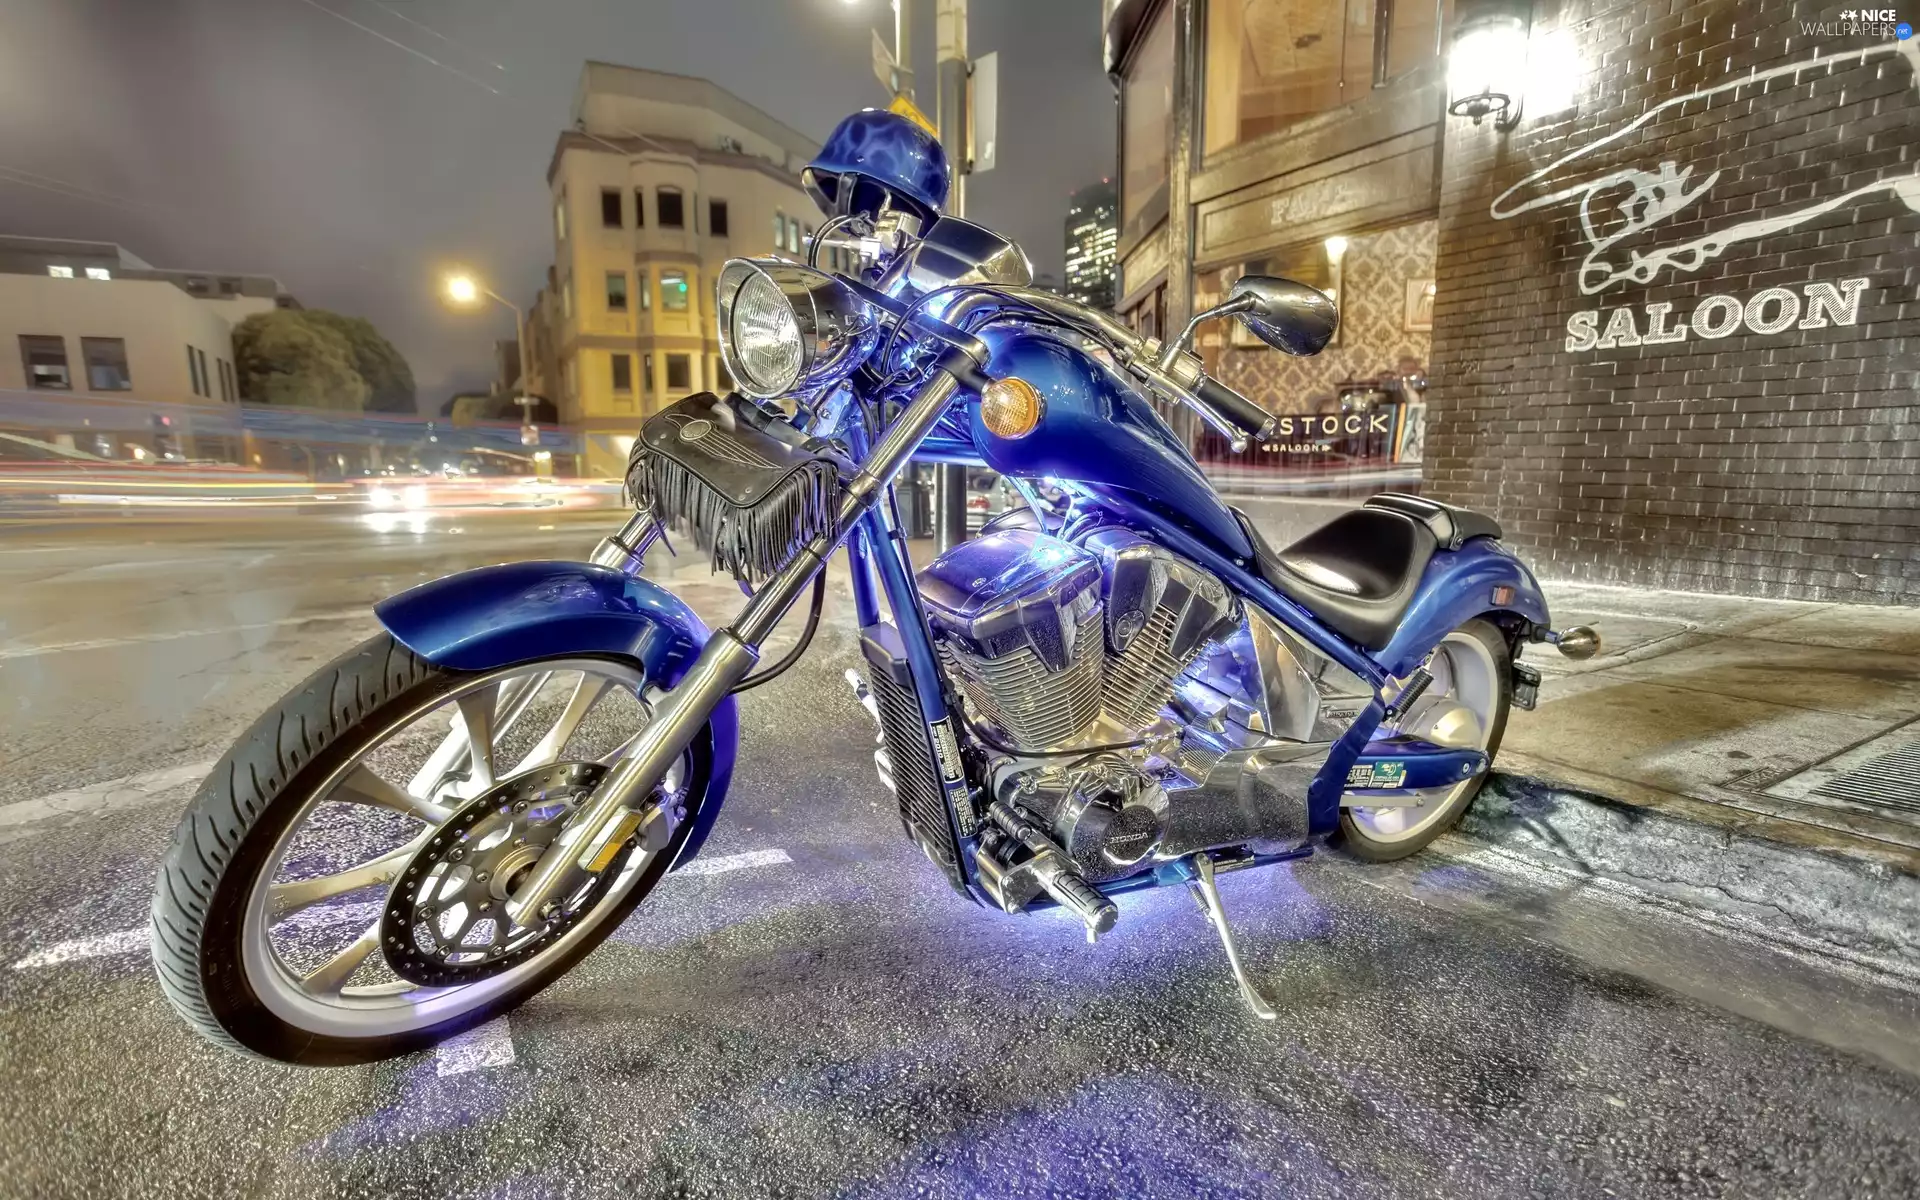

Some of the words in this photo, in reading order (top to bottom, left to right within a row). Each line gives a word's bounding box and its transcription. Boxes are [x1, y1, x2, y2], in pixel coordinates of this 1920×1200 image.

[1565, 277, 1870, 353] SALOON
[1237, 413, 1389, 435] STOCK
[1272, 443, 1319, 452] SALOON
[1109, 832, 1149, 844] HONDA
